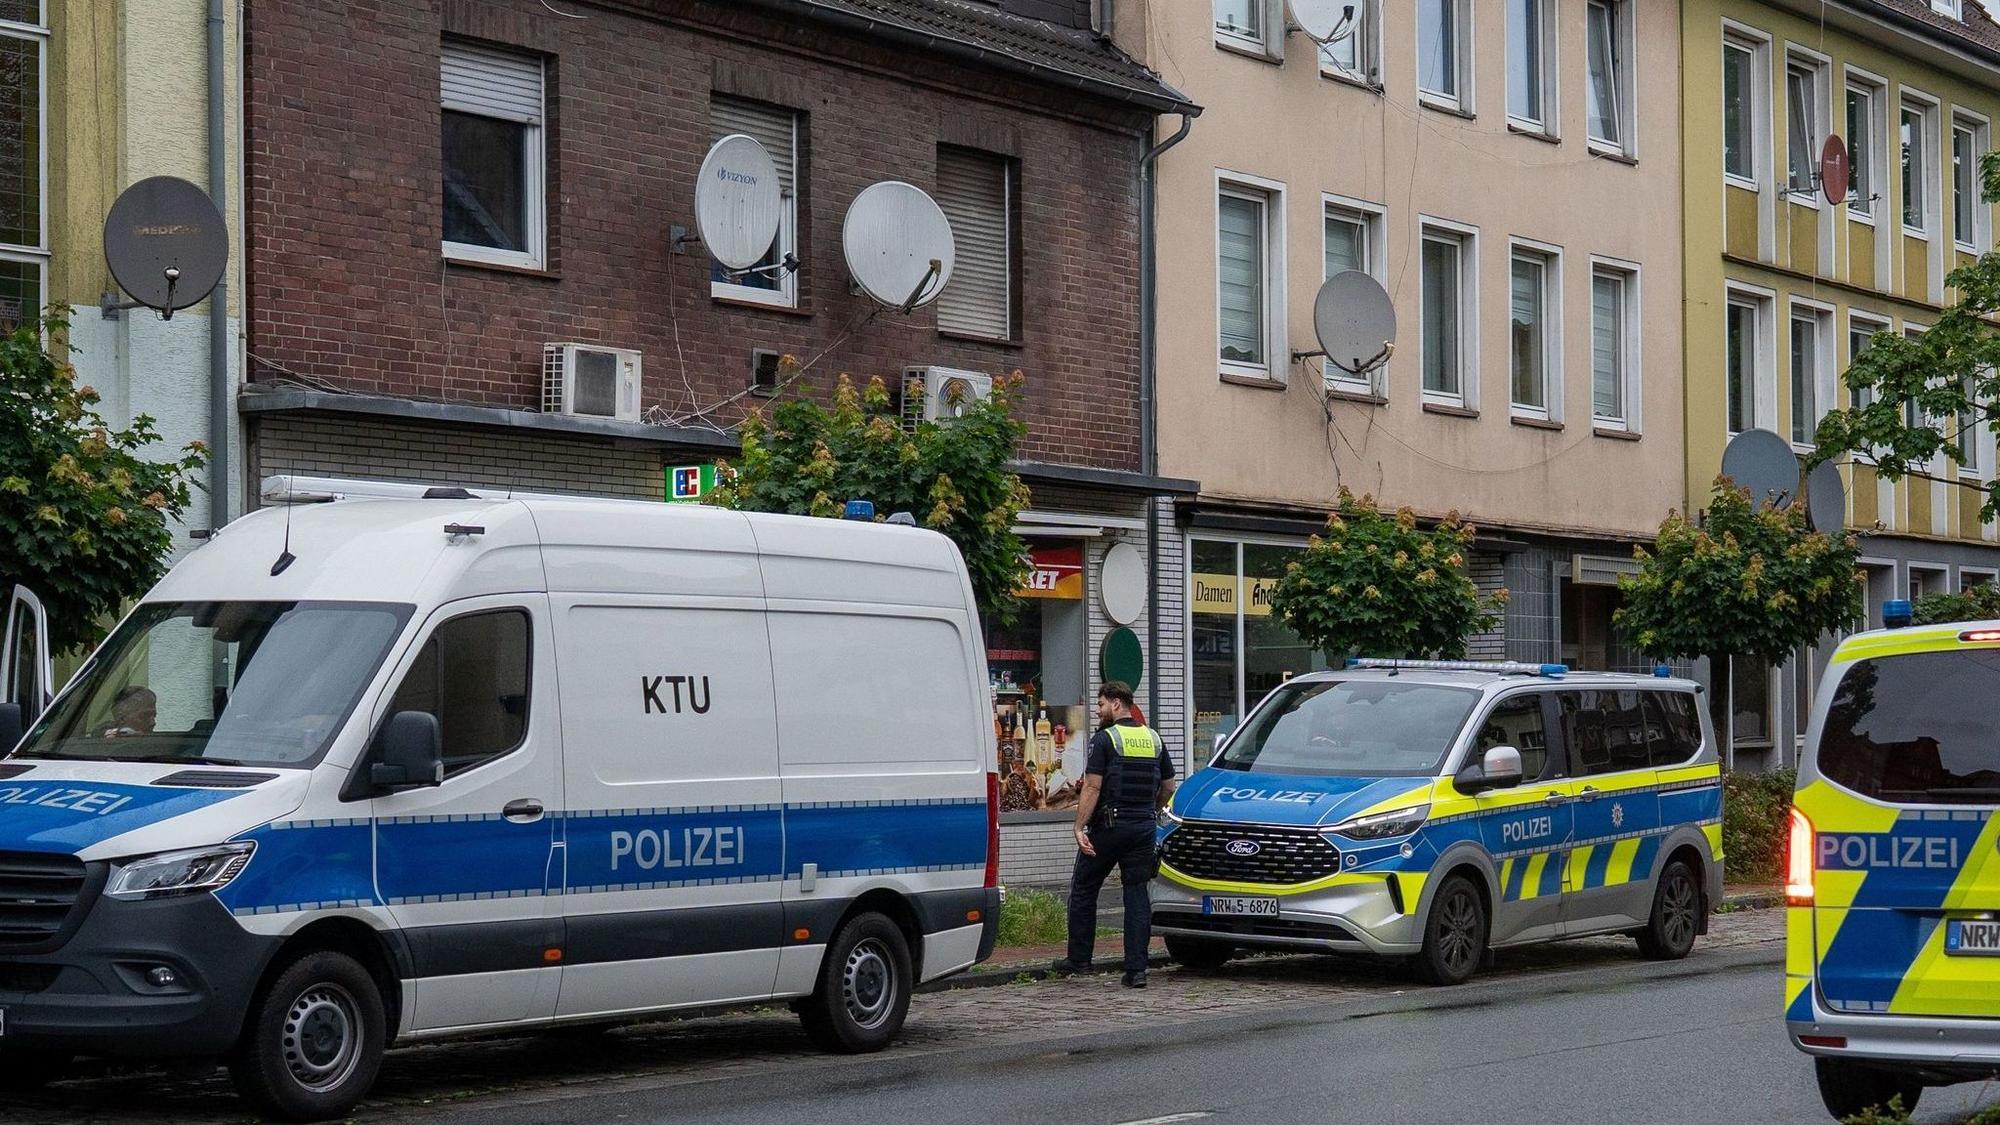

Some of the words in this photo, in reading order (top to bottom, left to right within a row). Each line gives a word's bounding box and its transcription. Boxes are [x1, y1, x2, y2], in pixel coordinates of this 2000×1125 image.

[1195, 580, 1232, 603] Damen
[642, 676, 711, 714] KTU
[1124, 737, 1153, 749] POLIZEI
[1211, 786, 1329, 804] POLIZEI
[1502, 815, 1553, 843] POLIZEI
[610, 826, 745, 871] POLIZEI
[1818, 835, 1958, 868] POLIZEI
